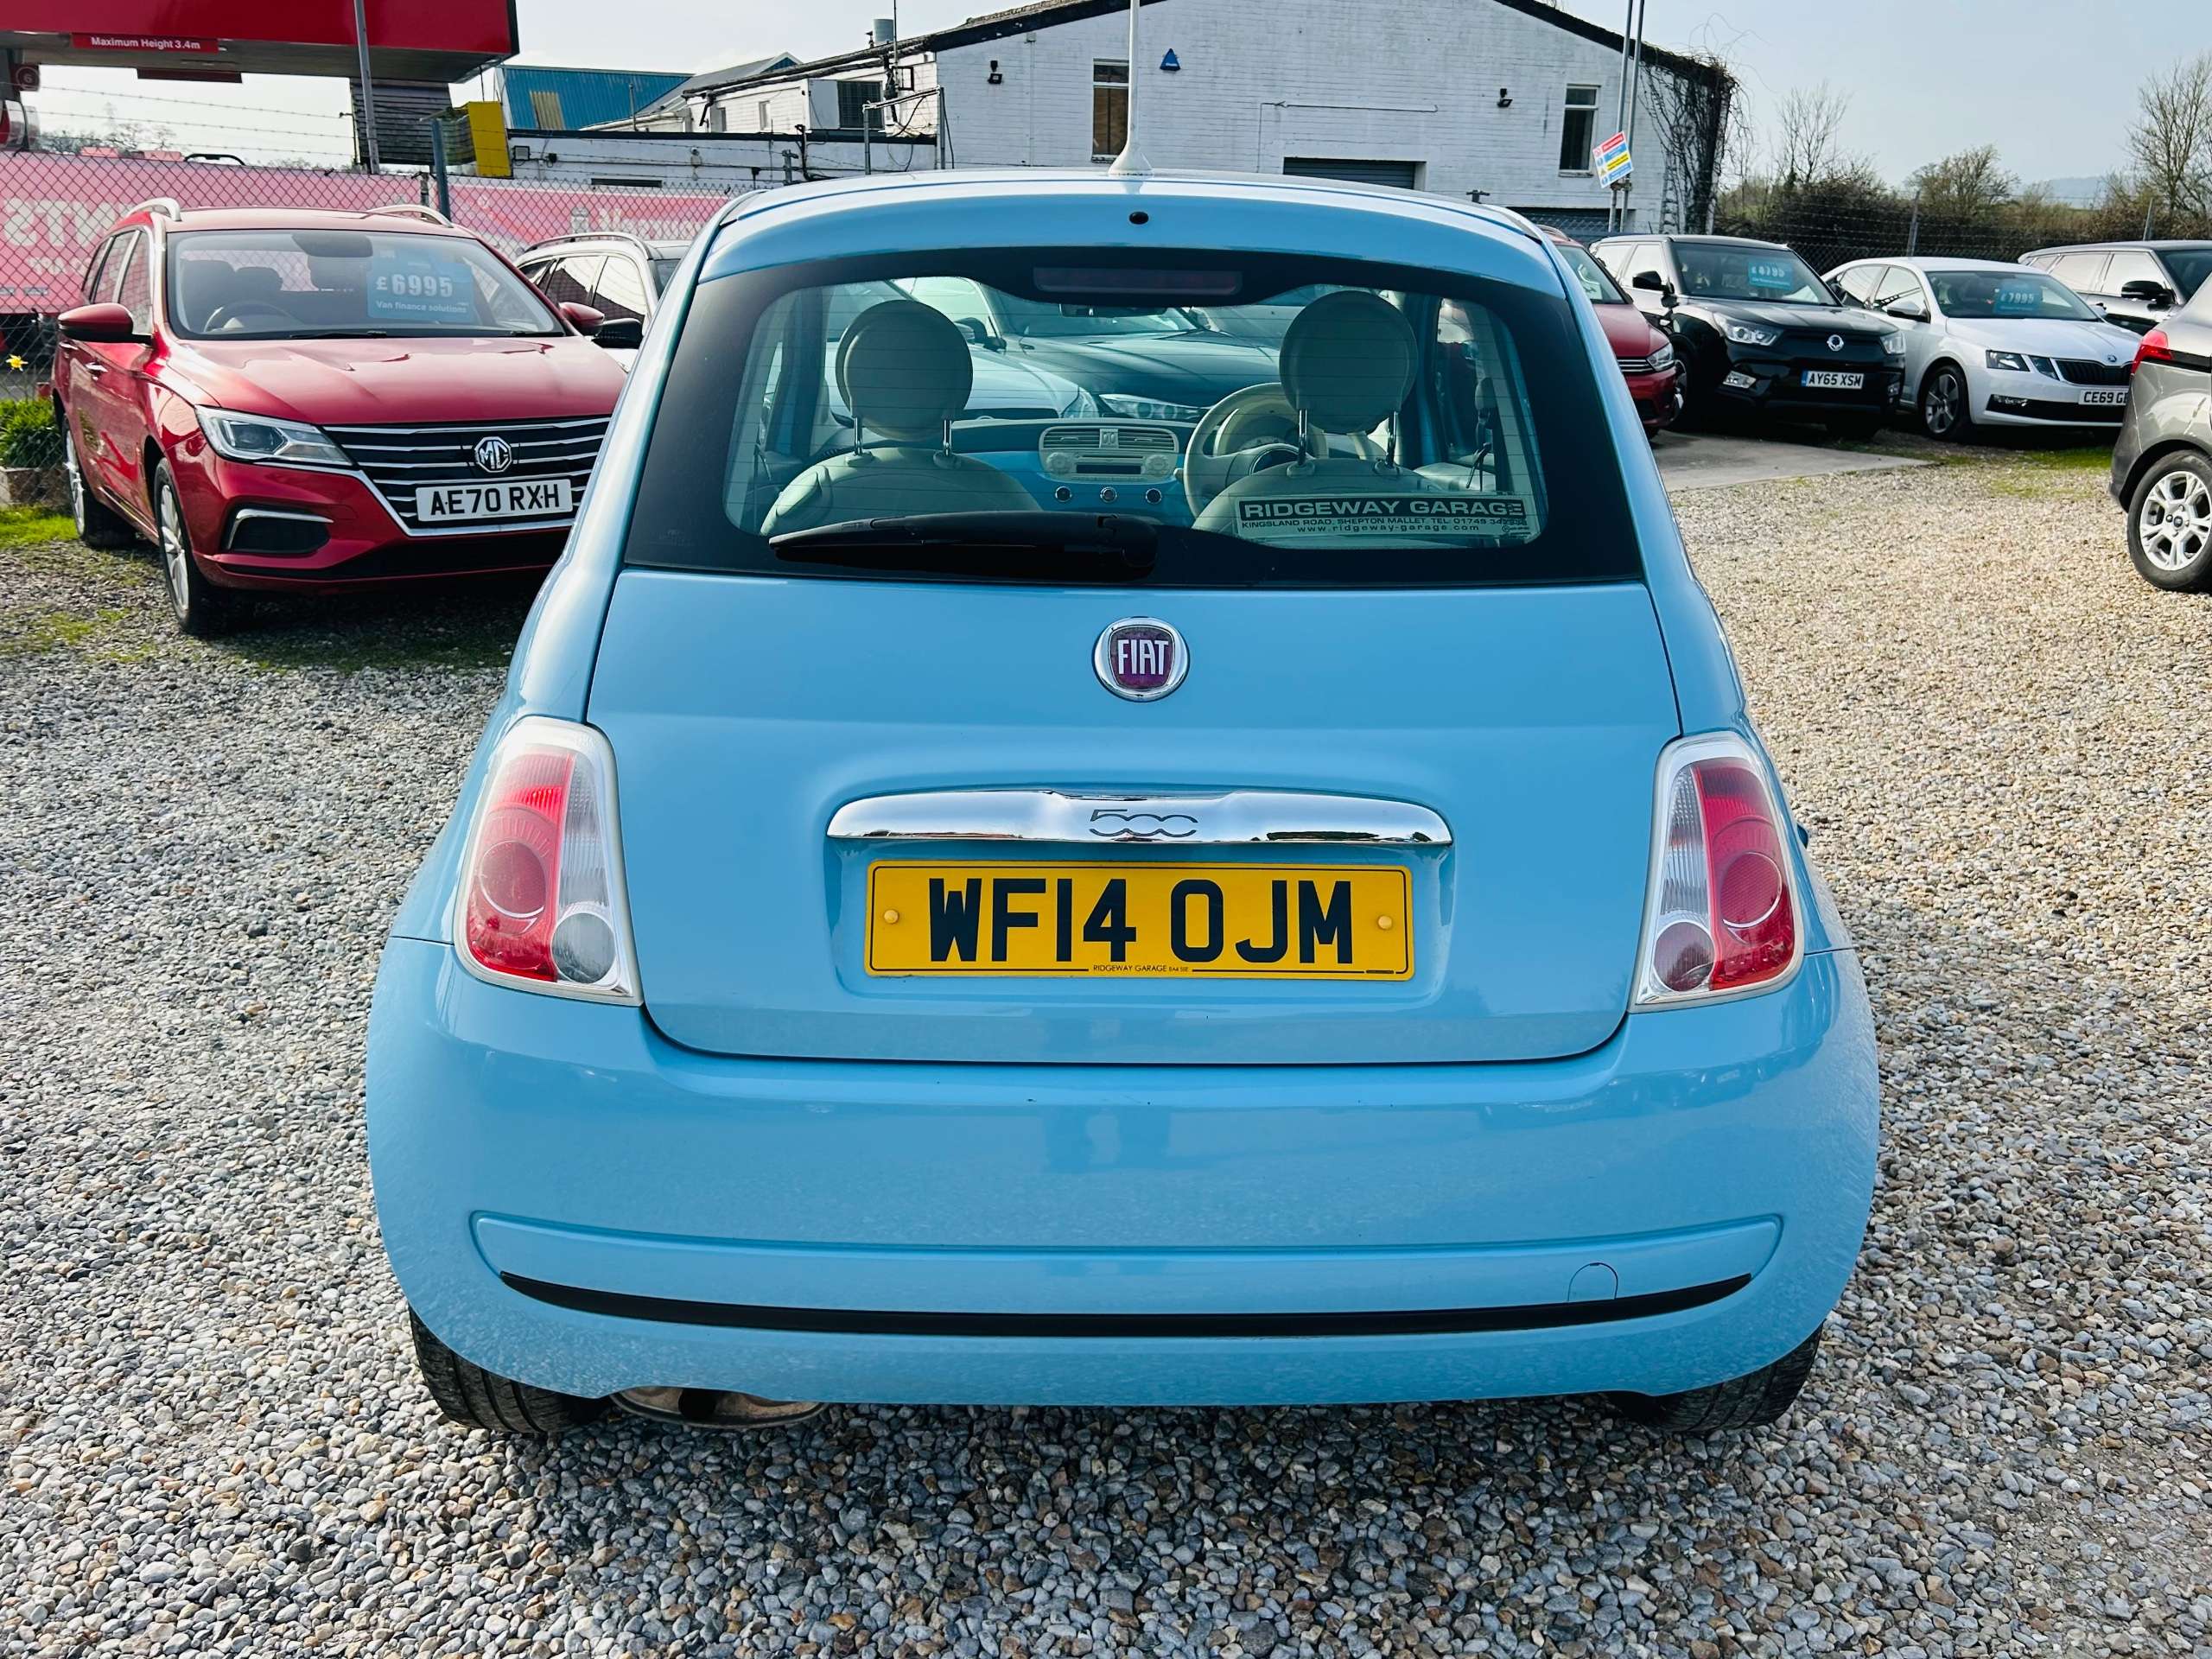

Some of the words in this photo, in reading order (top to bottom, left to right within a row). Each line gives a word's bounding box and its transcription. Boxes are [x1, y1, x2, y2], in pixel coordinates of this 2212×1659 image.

[91, 36, 138, 47] Maximum
[142, 39, 173, 49] Height
[175, 40, 201, 49] 3.4m
[375, 273, 454, 297] £6995
[376, 300, 393, 309] Van
[394, 301, 427, 311] finance
[1808, 372, 1839, 385] AY65
[1840, 374, 1862, 387] XSM
[2083, 391, 2114, 404] CE69
[478, 440, 511, 469] MG
[430, 486, 501, 516] AE70
[509, 484, 560, 511] RXH
[1244, 501, 1401, 518] RIDGEWAY
[1409, 500, 1523, 516] GARAGE
[1242, 519, 1300, 529] KINGSLAND
[1297, 524, 1479, 533] www.ridgeway-garage.com
[1117, 639, 1169, 675] FIAT
[1090, 809, 1198, 838] 500
[929, 878, 1137, 963] WF14
[1170, 879, 1353, 964] OJM
